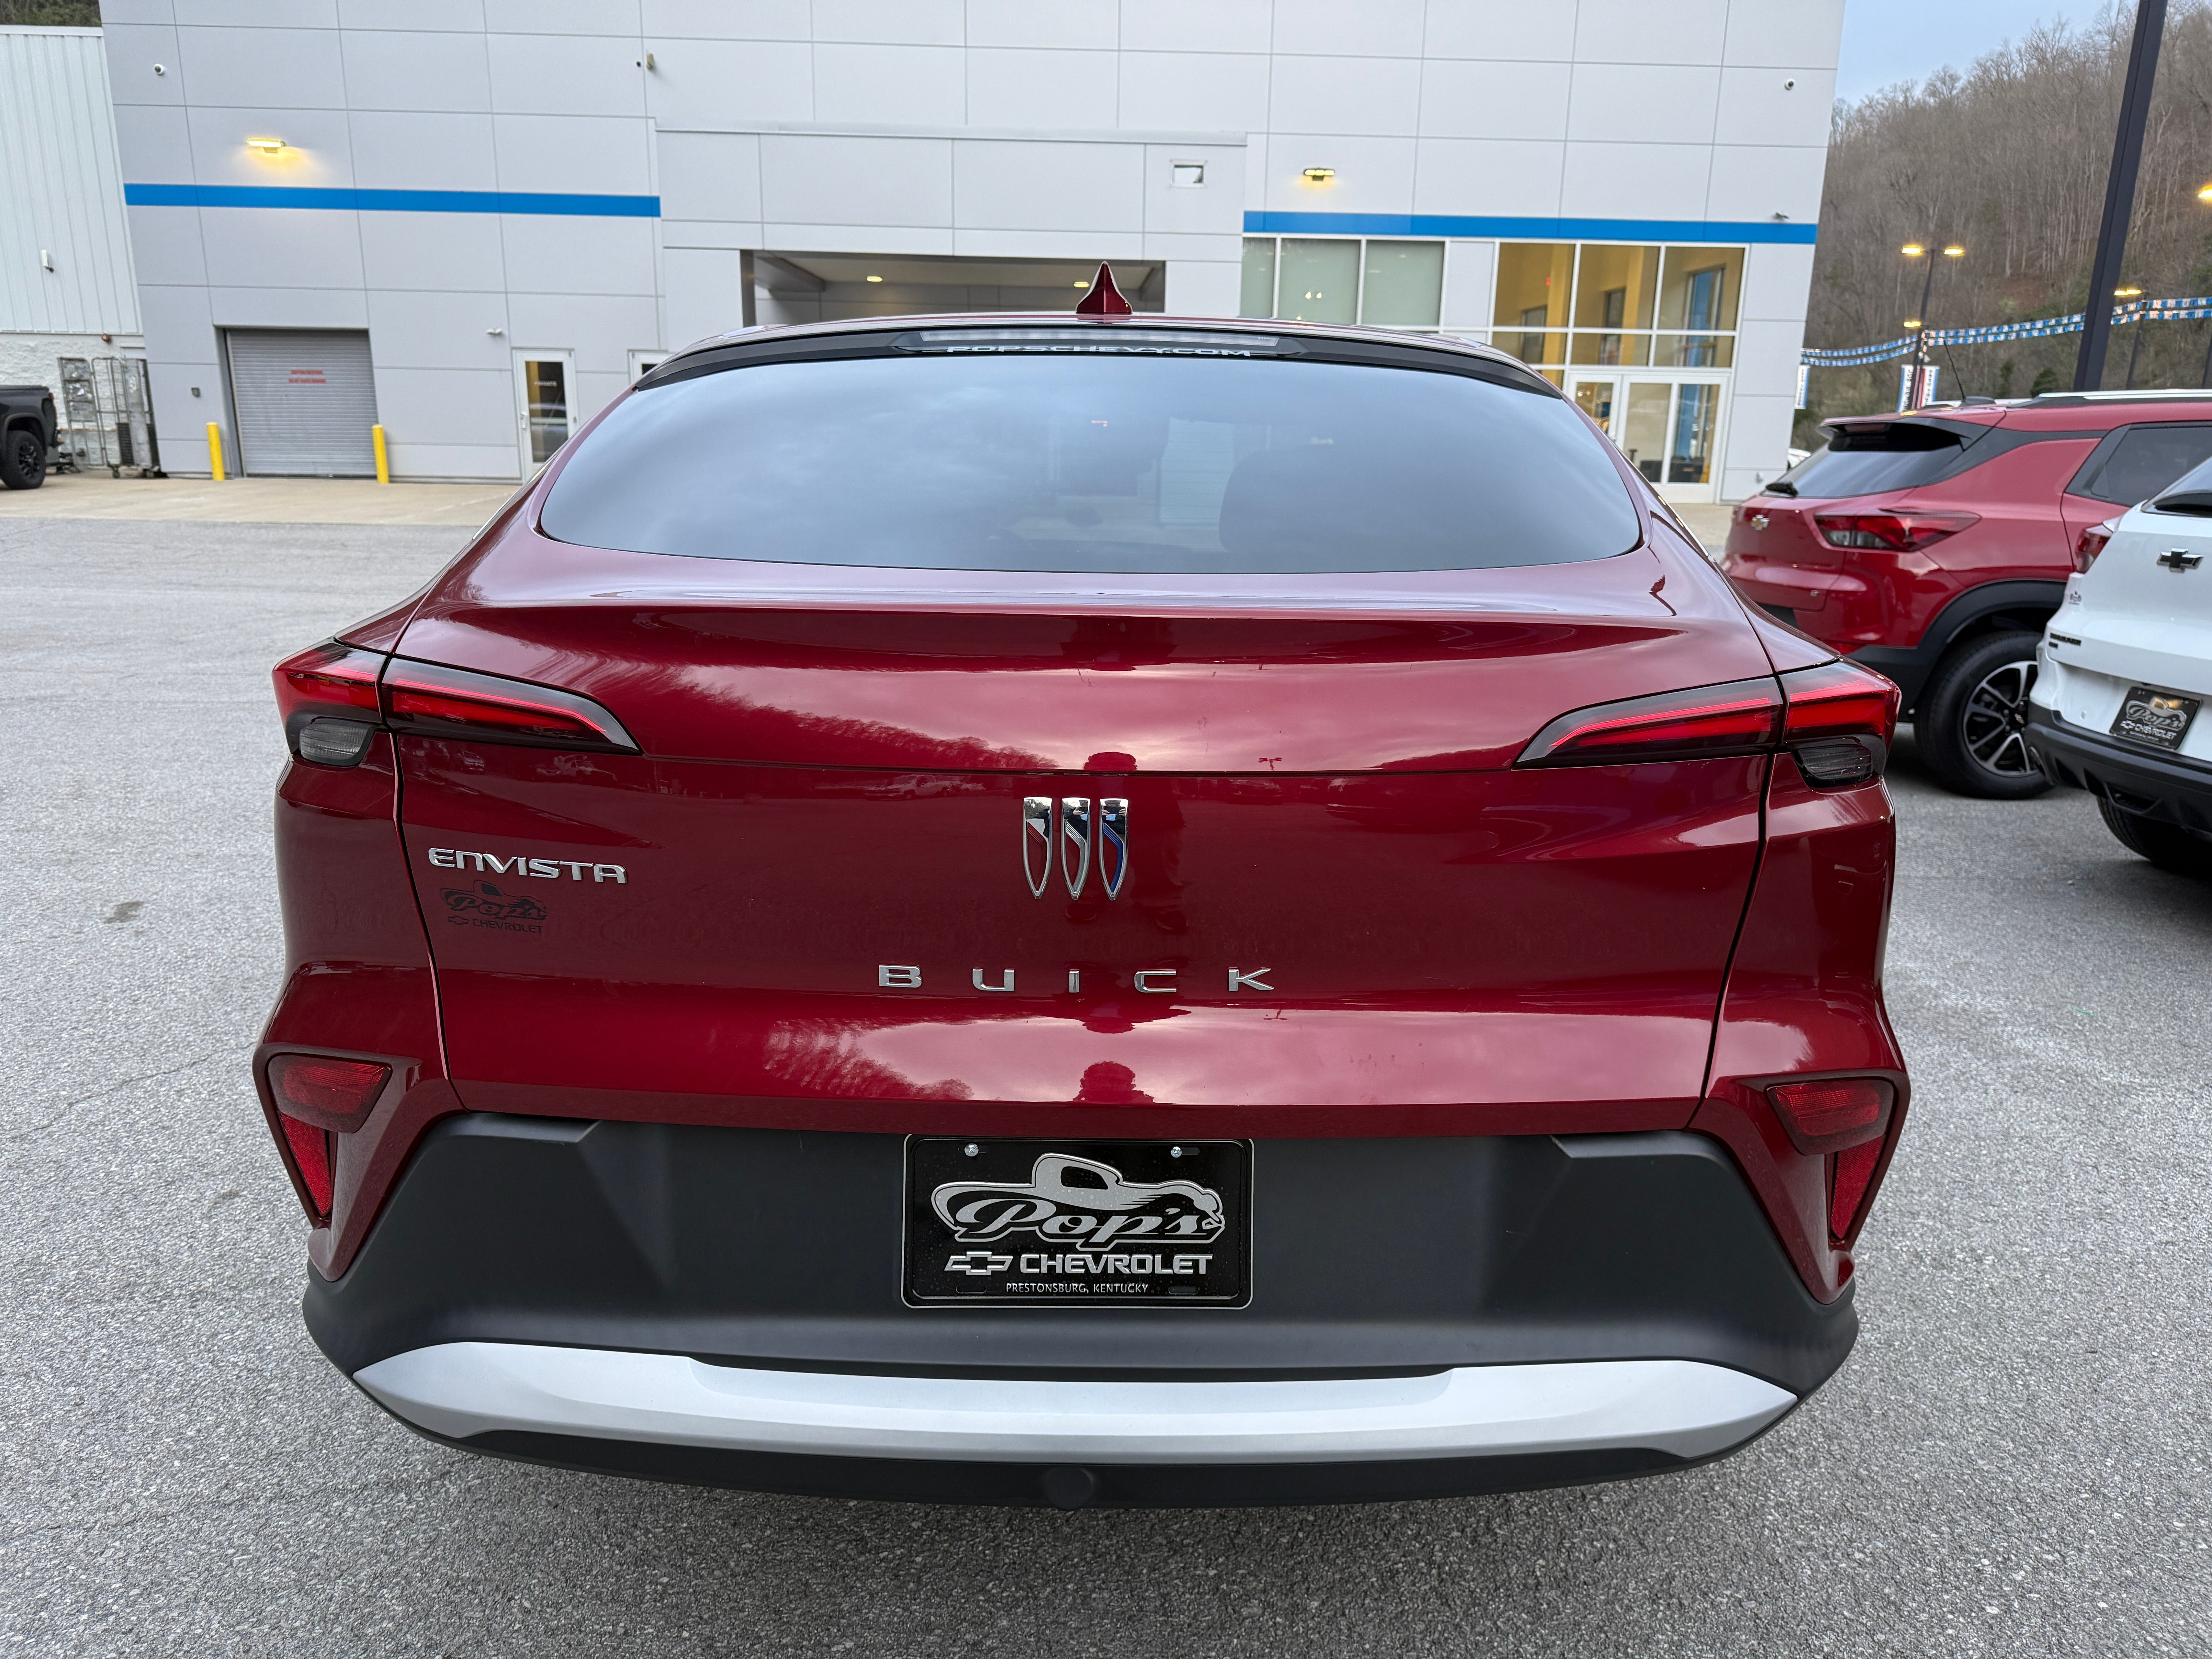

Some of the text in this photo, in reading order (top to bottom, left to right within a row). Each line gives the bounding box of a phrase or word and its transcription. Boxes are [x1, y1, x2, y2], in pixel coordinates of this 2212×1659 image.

[428, 848, 628, 884] ENVISTA
[472, 919, 543, 934] CHEVROLET
[879, 965, 1275, 993] BUICK
[955, 1199, 1207, 1243] Pop's
[1020, 1254, 1213, 1274] CHEVROLET
[1006, 1283, 1148, 1294] PRESTONSBURG, KENTUCKY
